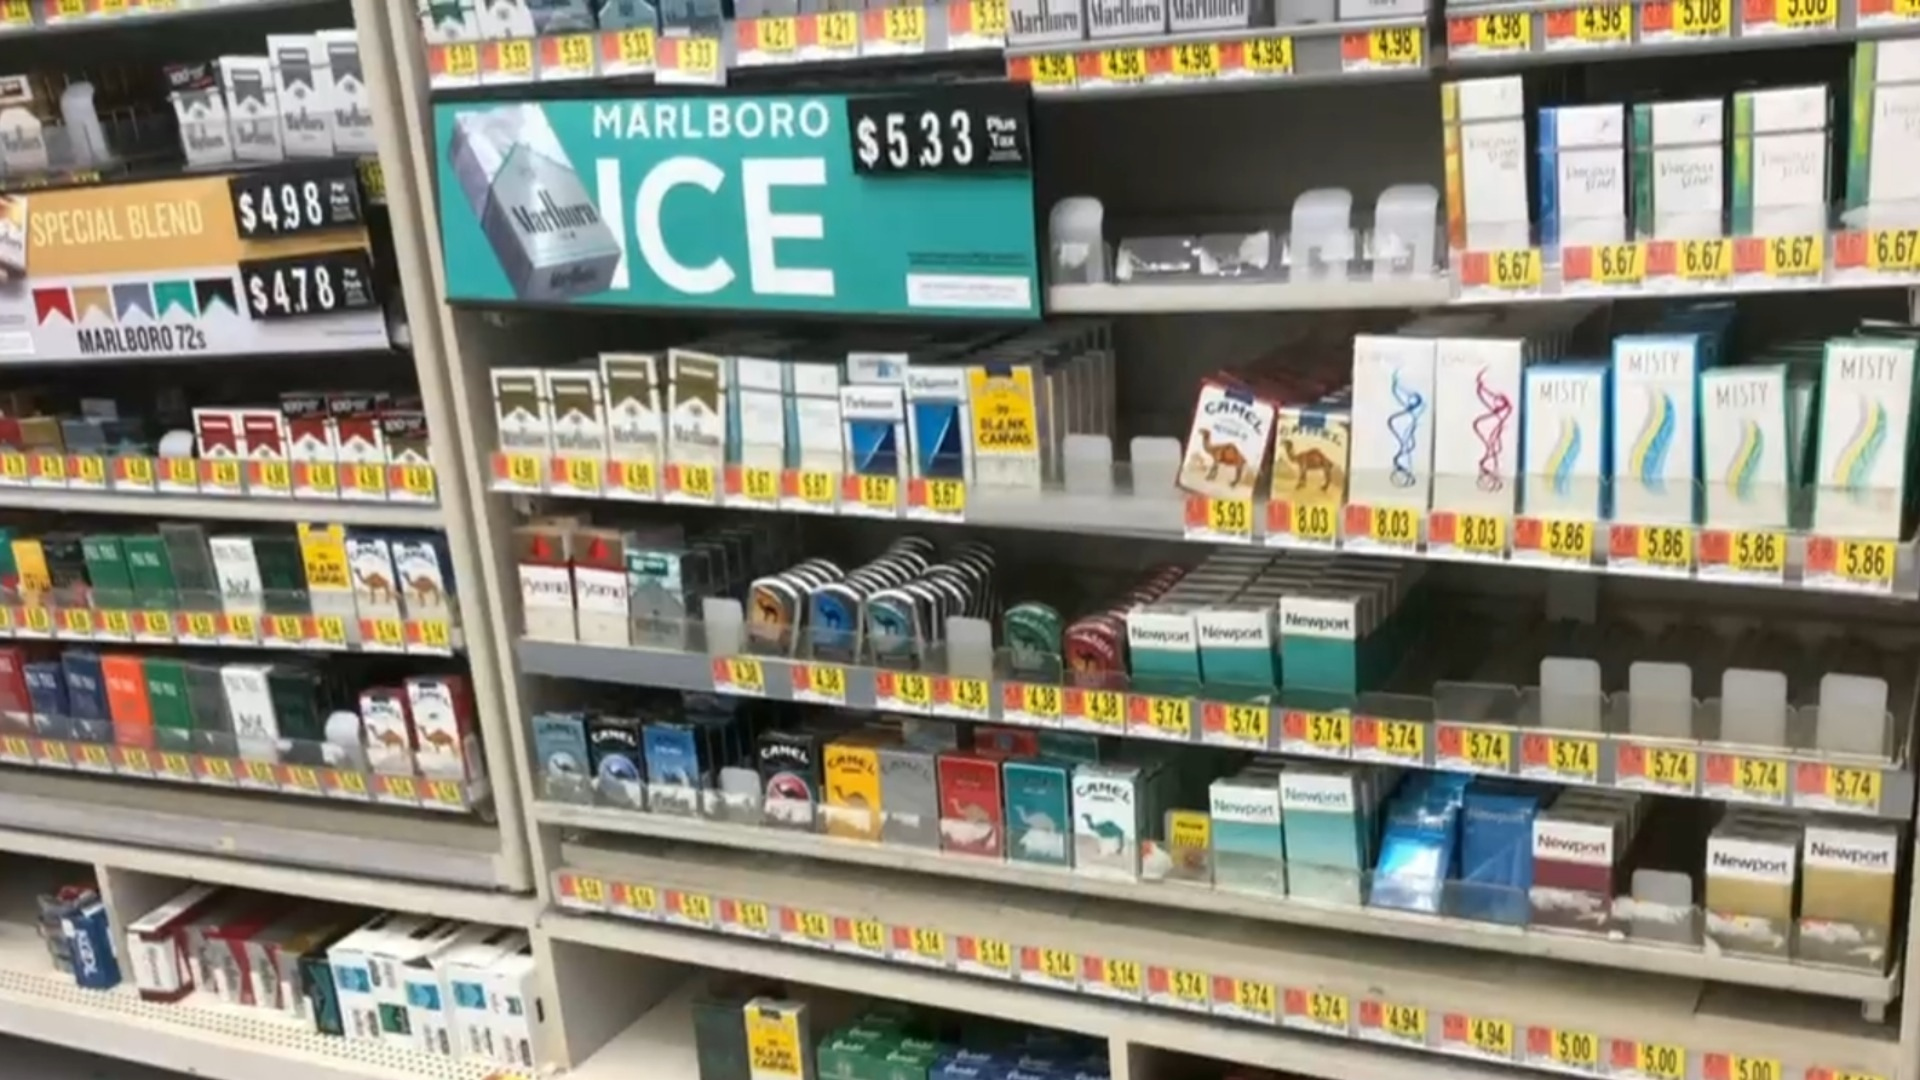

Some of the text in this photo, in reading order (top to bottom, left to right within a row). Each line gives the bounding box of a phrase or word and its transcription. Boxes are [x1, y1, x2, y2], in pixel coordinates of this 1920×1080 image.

[1584, 5, 1622, 34] 4.98
[1683, 0, 1721, 27] 5.08
[1485, 14, 1522, 40] 4.98
[1251, 38, 1284, 65] 4.98
[1378, 28, 1412, 57] 4.98
[1038, 54, 1067, 76] 4.98
[1108, 50, 1139, 74] 4.98
[1179, 45, 1210, 71] 4.98
[593, 103, 830, 139] MARLBORO
[31, 209, 123, 247] SPECIAL
[127, 201, 203, 239] BLEND
[596, 156, 835, 296] ICE
[1601, 244, 1637, 276] 6.67
[1684, 241, 1723, 274] 6.67
[1774, 237, 1814, 270] 6.67
[1877, 231, 1918, 265] 6.67
[1498, 251, 1531, 281] 6.67
[78, 324, 207, 354] MARLBORO 72s
[1628, 351, 1681, 375] MISTY
[1841, 355, 1898, 382] MISTY
[1540, 382, 1589, 404] MISTY
[1716, 382, 1770, 407] MISTY
[1204, 400, 1264, 436] CAMEL
[1216, 503, 1246, 529] 5.93
[1299, 508, 1329, 534] 8.03
[1378, 511, 1410, 537] 8.03
[1464, 518, 1497, 545] 8.03
[1550, 521, 1585, 551] 5.86
[1647, 530, 1684, 558] 5.86
[1738, 534, 1775, 563] 5.86
[1847, 546, 1885, 576] 5.86
[1132, 626, 1190, 644] Newport
[1203, 624, 1263, 642] Newport
[1286, 612, 1350, 632] Newport
[1155, 703, 1184, 726] 5.74
[1232, 707, 1261, 732] 5.74
[591, 729, 637, 747] CAMEL
[1312, 716, 1343, 741] 5.74
[1386, 724, 1416, 748] 5.74
[761, 745, 810, 764] CAMEL
[1471, 732, 1503, 759] 5.74
[1555, 740, 1590, 768] 5.74
[827, 753, 877, 775] CAMEL
[1653, 750, 1689, 778] 5.74
[1743, 760, 1779, 788] 5.74
[1077, 783, 1131, 805] CAMEL
[1835, 769, 1872, 797] 5.74
[1215, 798, 1275, 818] Newport
[1285, 787, 1348, 806] Newport
[1538, 835, 1607, 856] Newport
[1810, 842, 1889, 865] Newport
[1713, 852, 1788, 873] Newport
